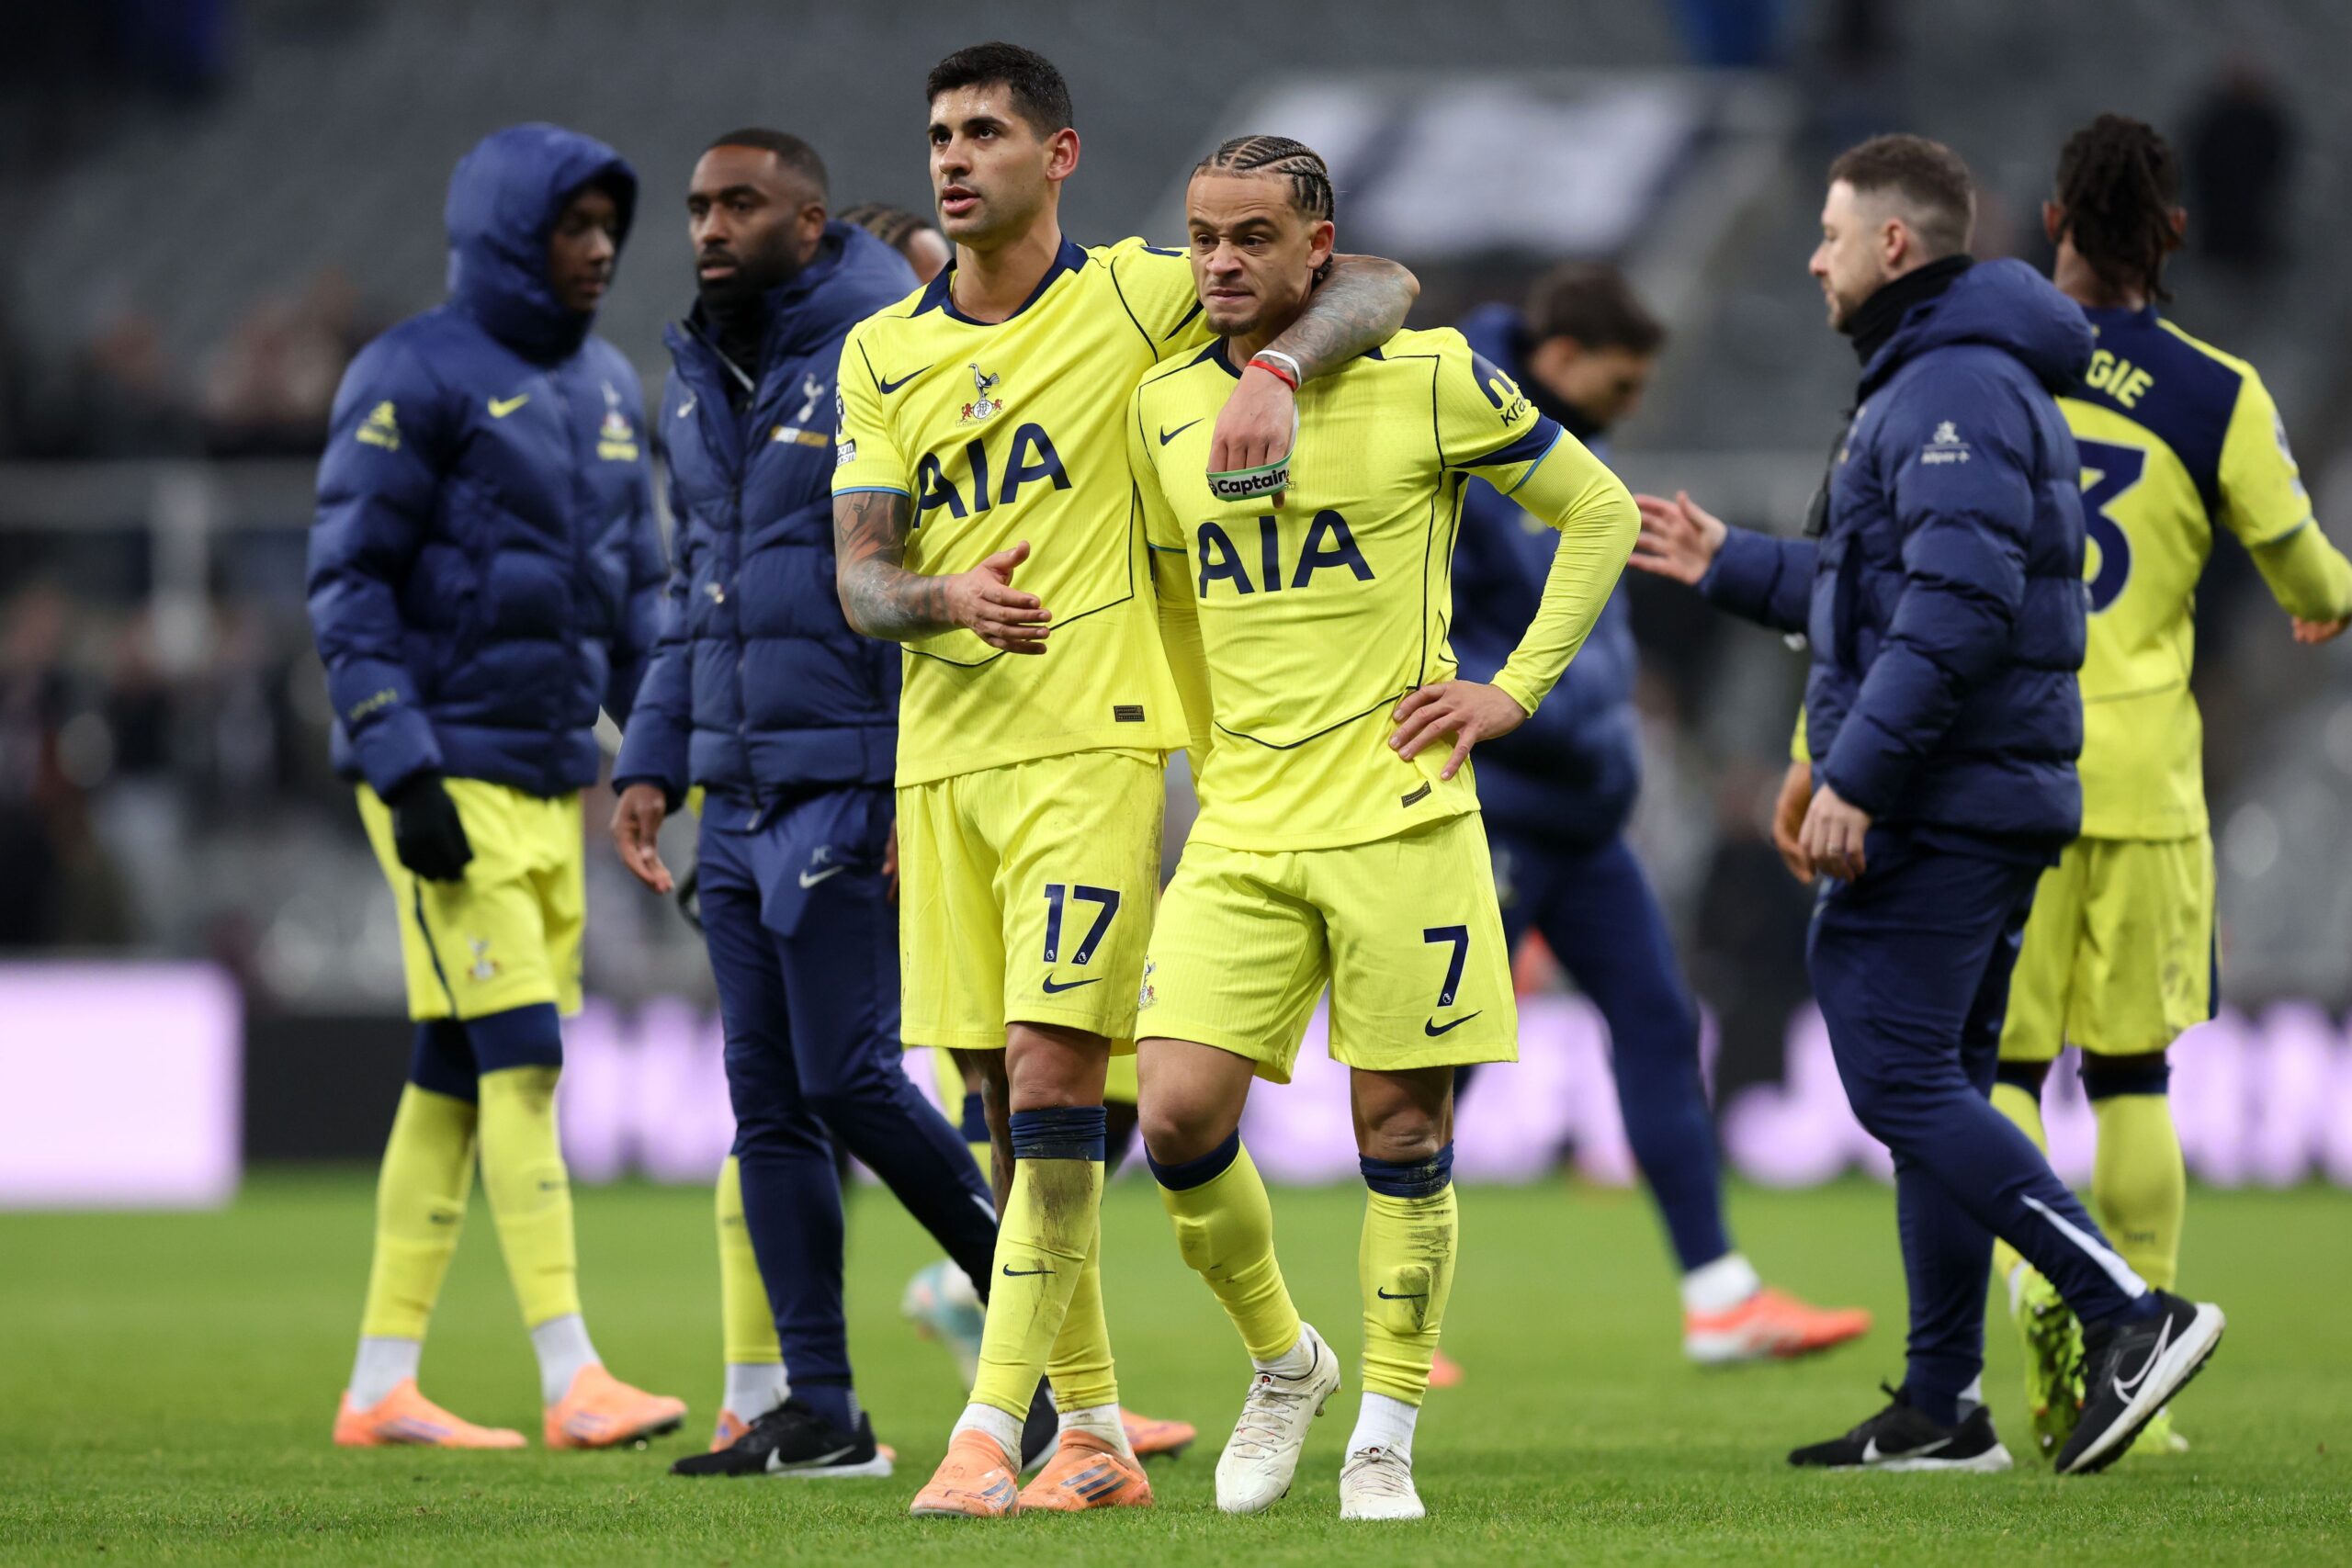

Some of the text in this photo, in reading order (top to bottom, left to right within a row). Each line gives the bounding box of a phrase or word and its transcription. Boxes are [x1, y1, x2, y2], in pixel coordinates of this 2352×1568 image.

[2086, 349, 2154, 409] GIE
[912, 423, 1072, 528] AIA
[1217, 469, 1287, 495] Captain
[1197, 510, 1375, 598] AIA
[1043, 884, 1121, 966] 17
[1423, 924, 1470, 1008] 7
